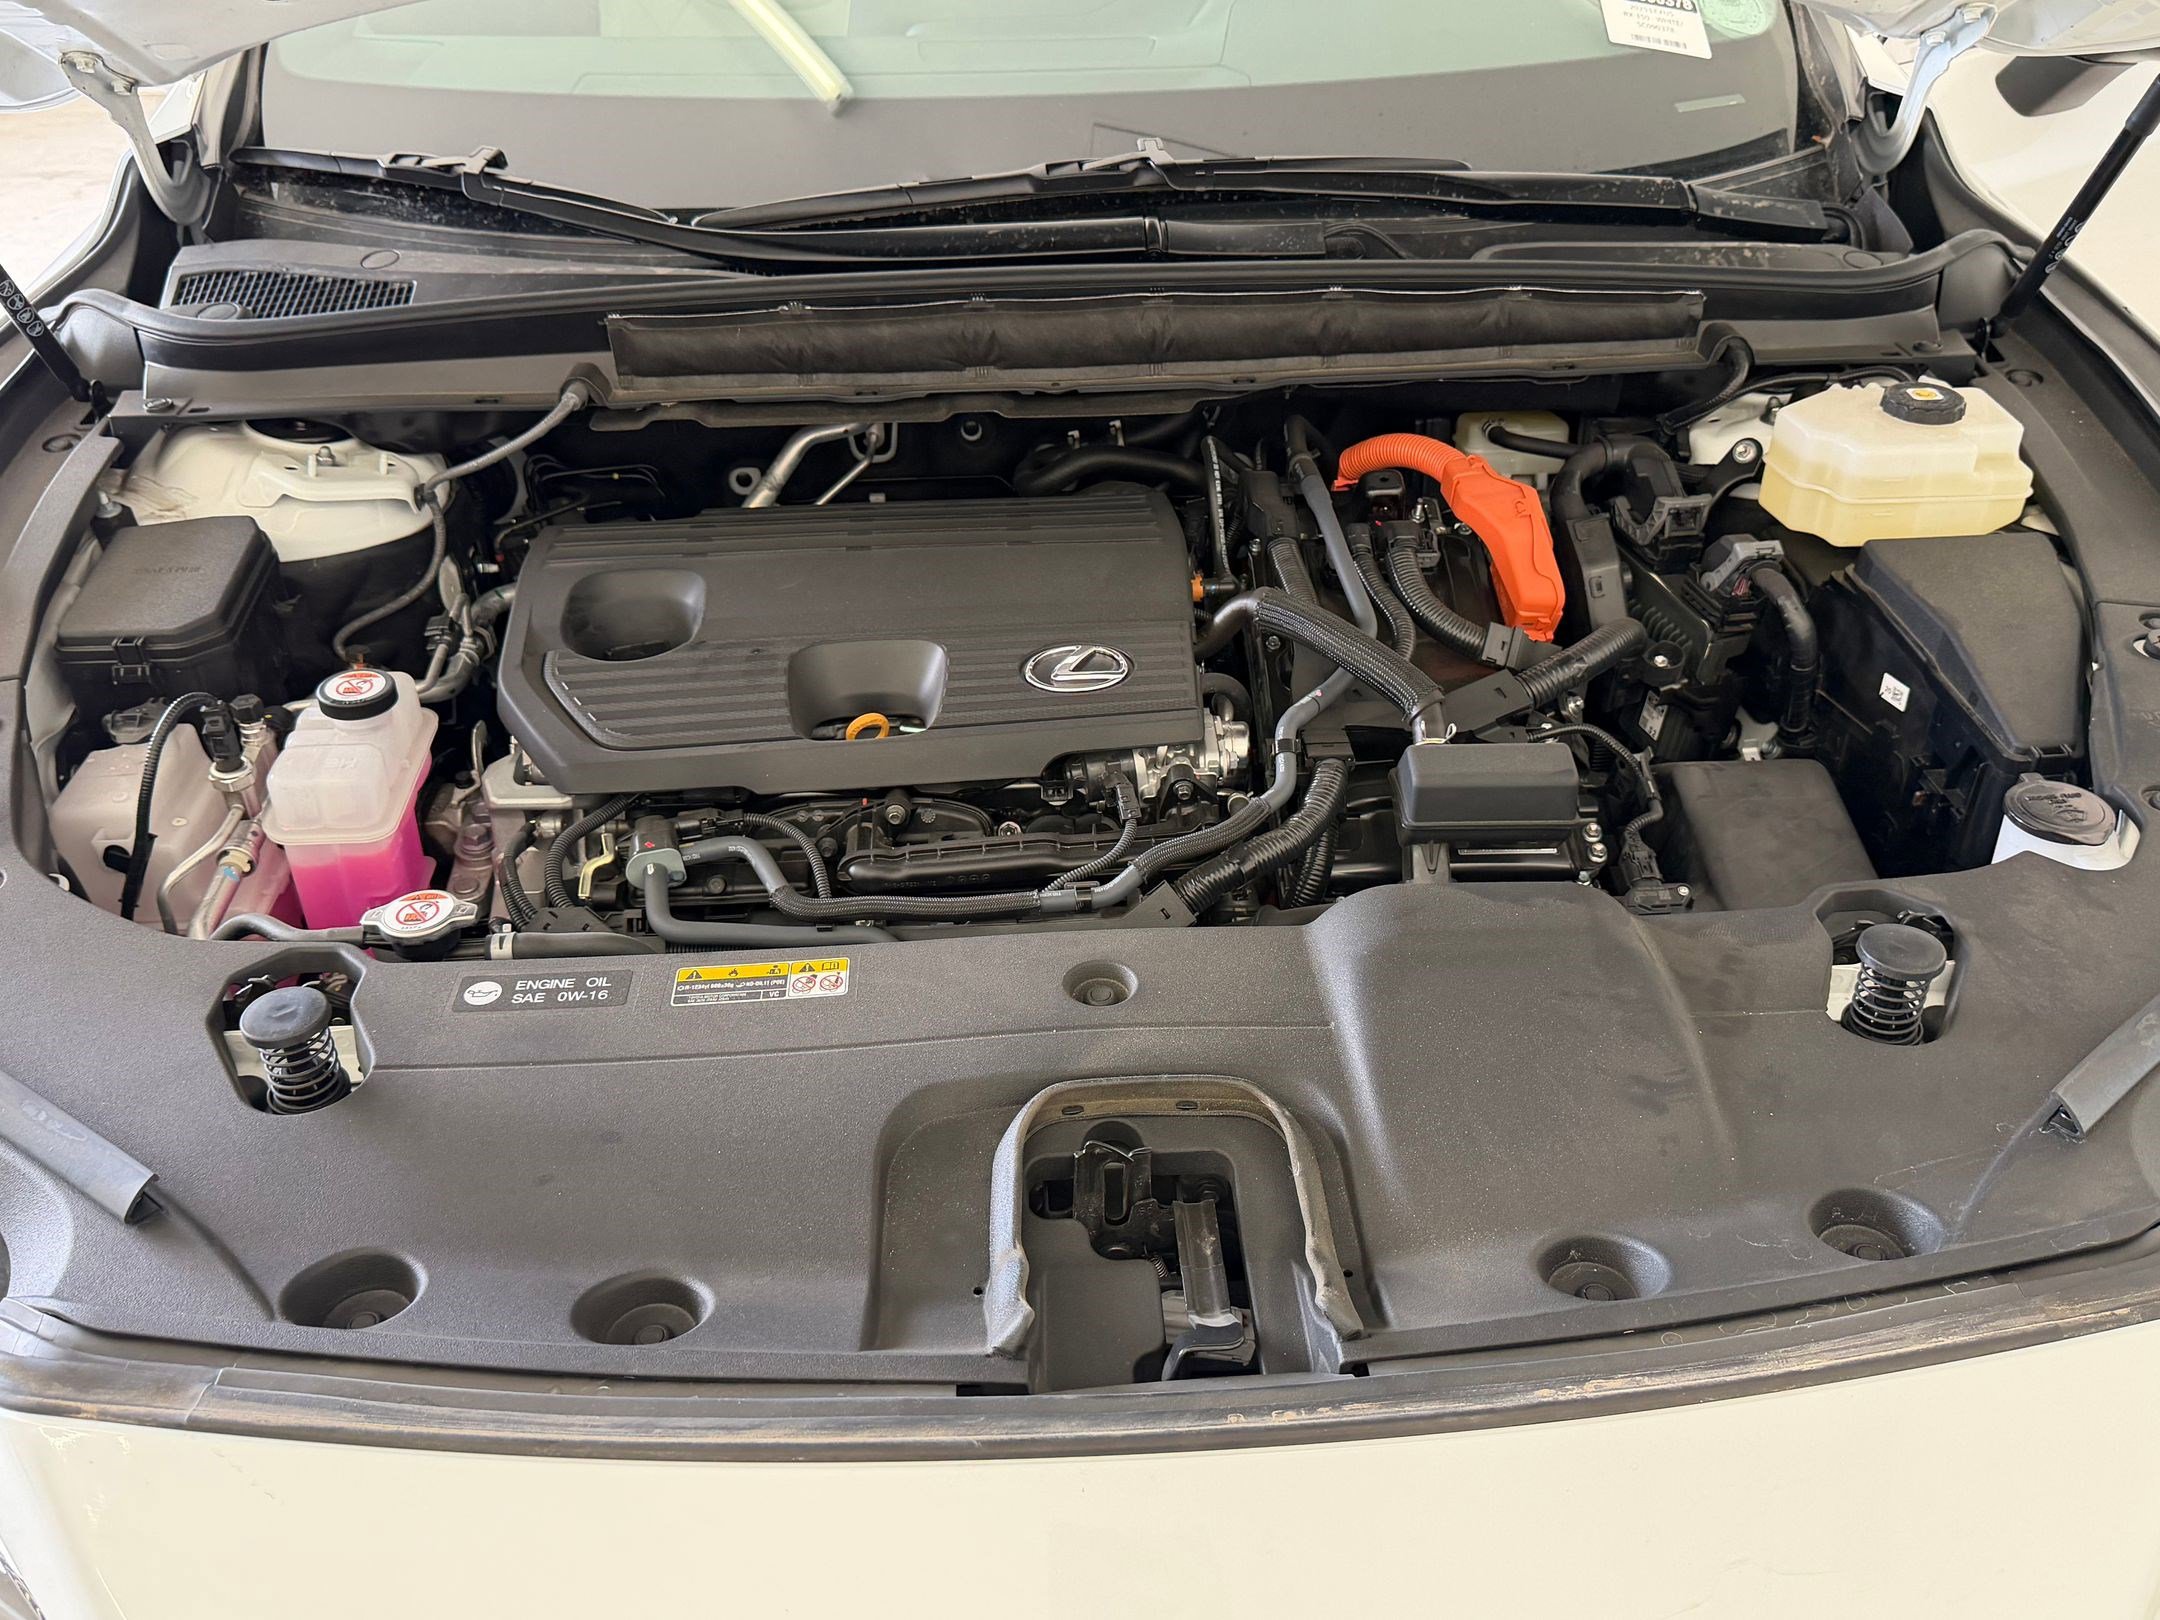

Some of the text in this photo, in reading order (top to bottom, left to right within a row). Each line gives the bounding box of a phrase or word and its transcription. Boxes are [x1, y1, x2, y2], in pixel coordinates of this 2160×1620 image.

[515, 976, 612, 991] ENGINE OIL
[512, 990, 609, 1004] SAE 0W-16
